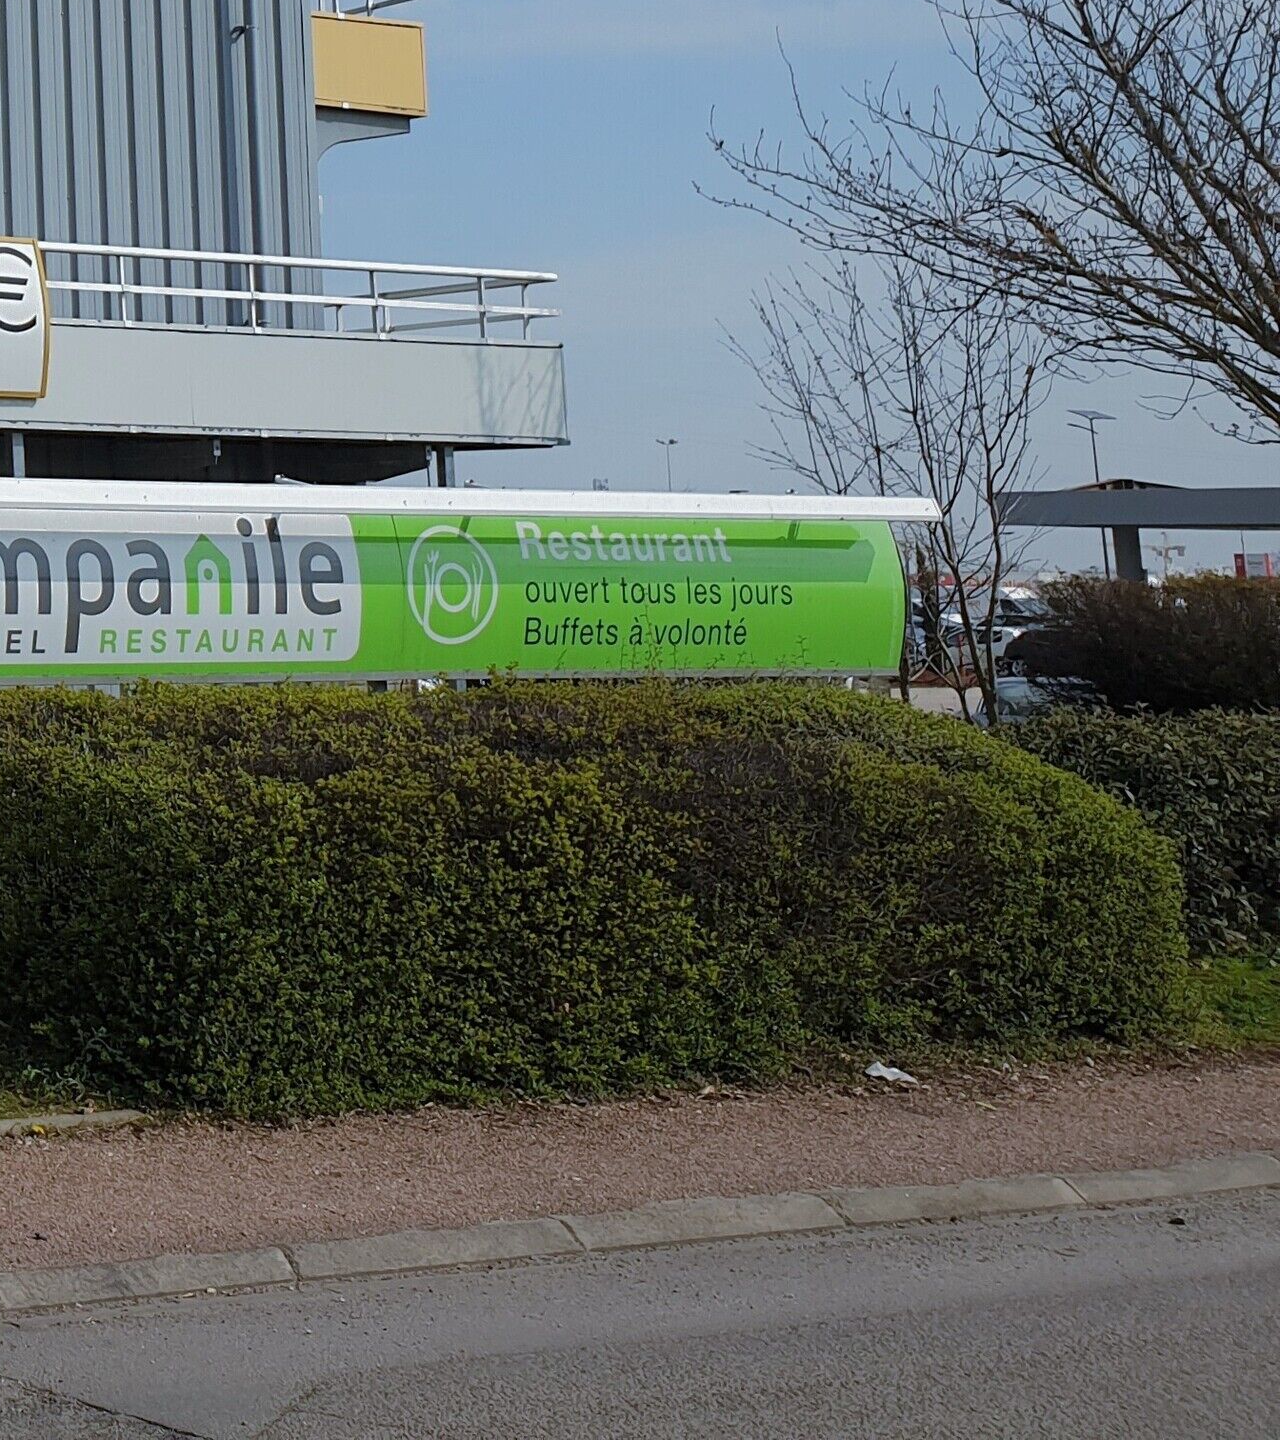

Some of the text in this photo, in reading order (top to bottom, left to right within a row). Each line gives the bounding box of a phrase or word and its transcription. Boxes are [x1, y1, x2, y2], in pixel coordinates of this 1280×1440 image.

[515, 521, 732, 563] Restaurant
[525, 577, 794, 612] ouvert tous les jours
[99, 628, 338, 653] RESTAURANT
[524, 616, 747, 646] Buffets à volonté
